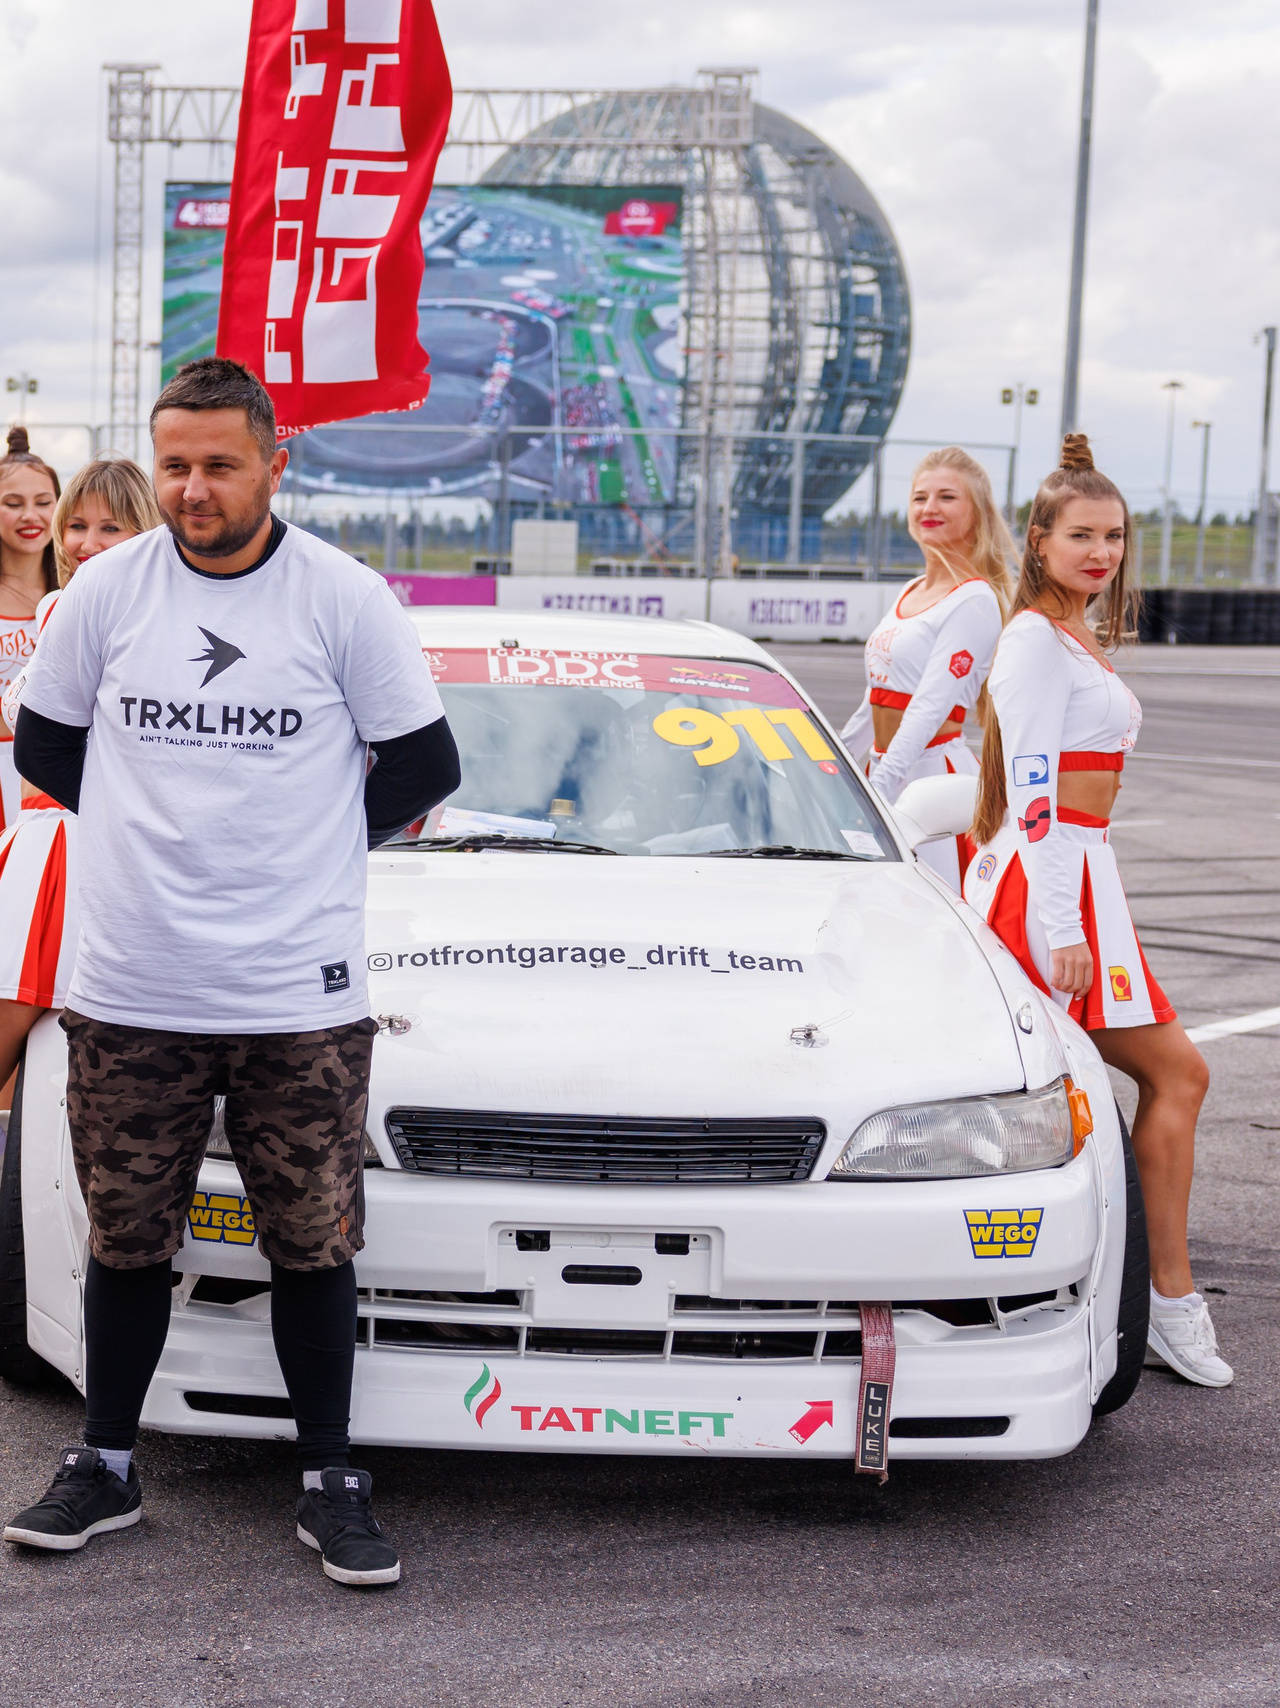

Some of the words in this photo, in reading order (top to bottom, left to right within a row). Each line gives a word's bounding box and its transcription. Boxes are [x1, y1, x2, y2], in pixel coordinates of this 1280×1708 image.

[487, 648, 559, 659] IGORA
[570, 651, 639, 663] DRIVE
[487, 656, 642, 682] IDDC
[490, 676, 540, 685] DRIFT
[543, 677, 646, 690] CHALLENGE
[120, 696, 303, 738] TRXLHXD
[139, 735, 162, 744] AIN'T
[164, 737, 203, 748] TALKING
[206, 740, 229, 749] JUST
[231, 742, 275, 751] WORKING
[653, 706, 838, 767] 911
[189, 1207, 255, 1231] WEGO
[969, 1224, 1037, 1243] WEGO
[510, 1405, 734, 1438] TATNEFT
[865, 1387, 883, 1452] LUKE
